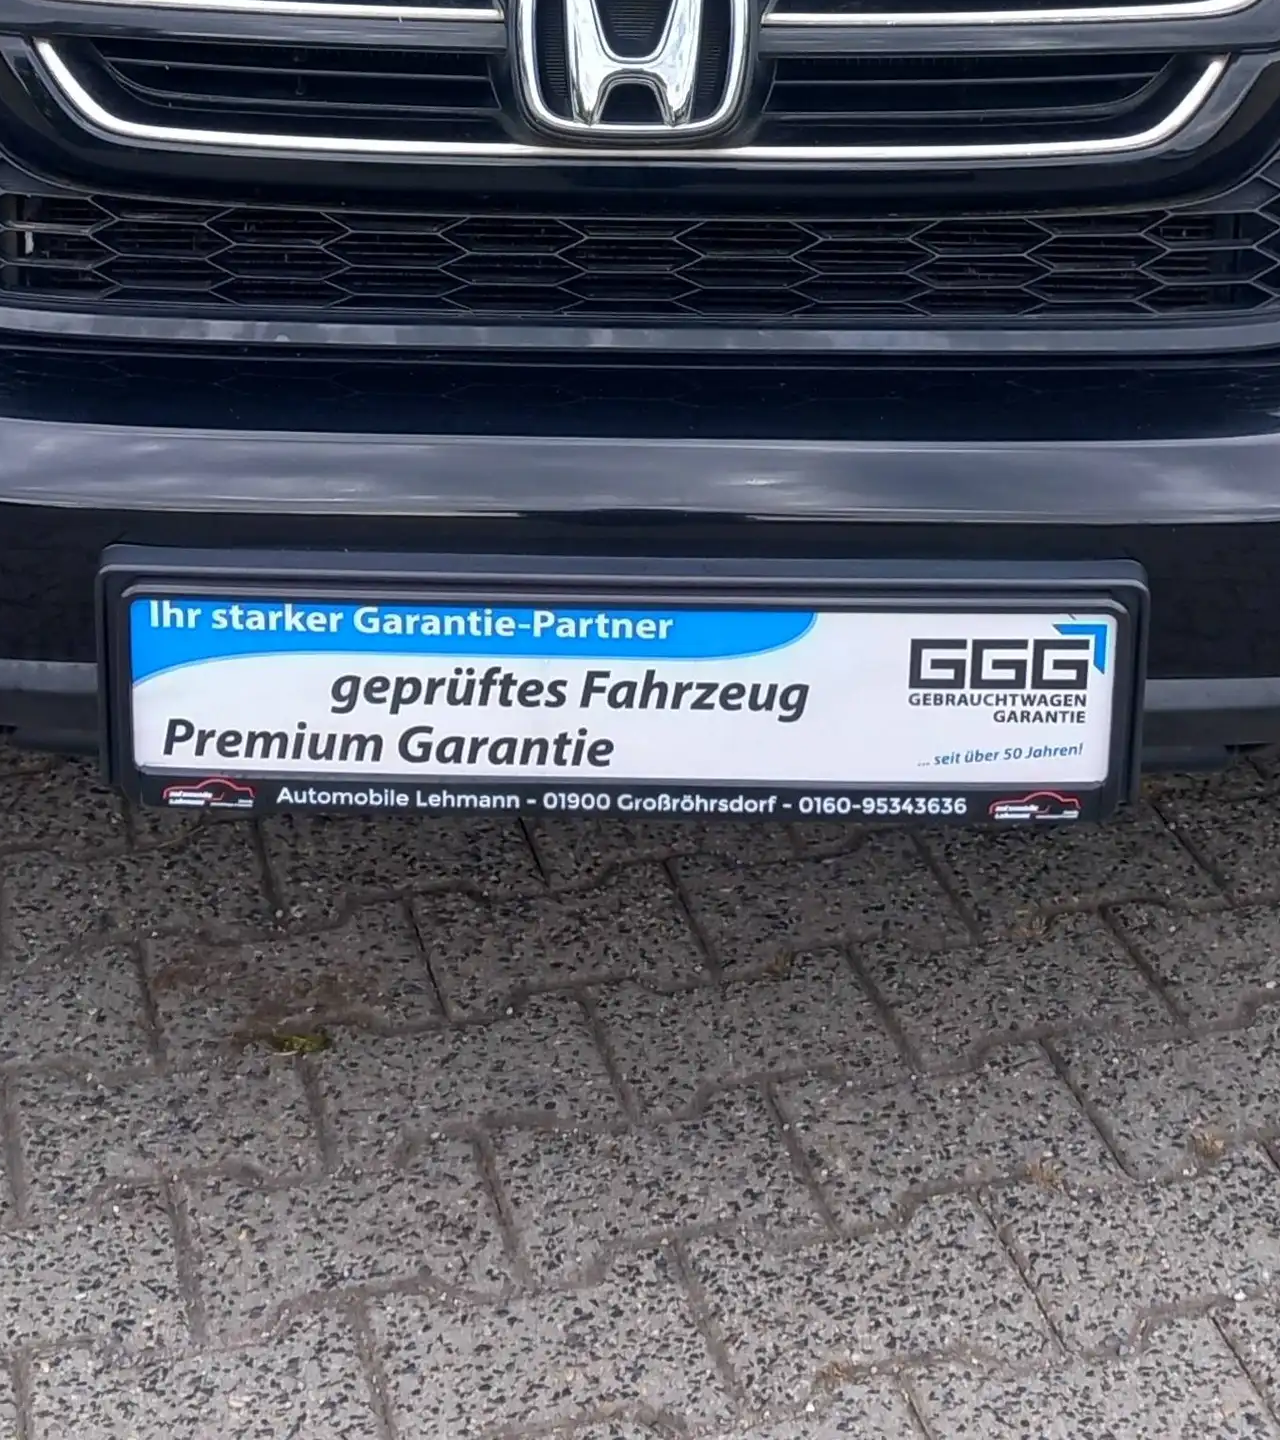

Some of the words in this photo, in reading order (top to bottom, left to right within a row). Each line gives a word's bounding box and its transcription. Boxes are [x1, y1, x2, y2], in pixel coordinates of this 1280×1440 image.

[149, 600, 202, 630] Ihr
[211, 603, 344, 633] starker
[353, 607, 674, 640] Garantie-Partner
[908, 638, 1090, 690] GGG
[330, 666, 567, 715] geprüftes
[579, 669, 810, 723] Fahrzeug
[908, 692, 1087, 708] GEBRAUCHTWAGEN
[993, 710, 1086, 724] GARANTIE
[163, 718, 384, 763] Premium
[397, 726, 615, 768] Garantie
[934, 751, 960, 766] seit
[964, 747, 999, 764] über
[1003, 747, 1022, 761] 50
[1024, 742, 1084, 760] Jahren!
[276, 786, 410, 807] Automobile
[416, 789, 520, 810] Lehmann
[542, 791, 612, 811] 01900
[617, 792, 778, 814] Großröhrsdorf
[799, 795, 968, 815] 0160-95343636
